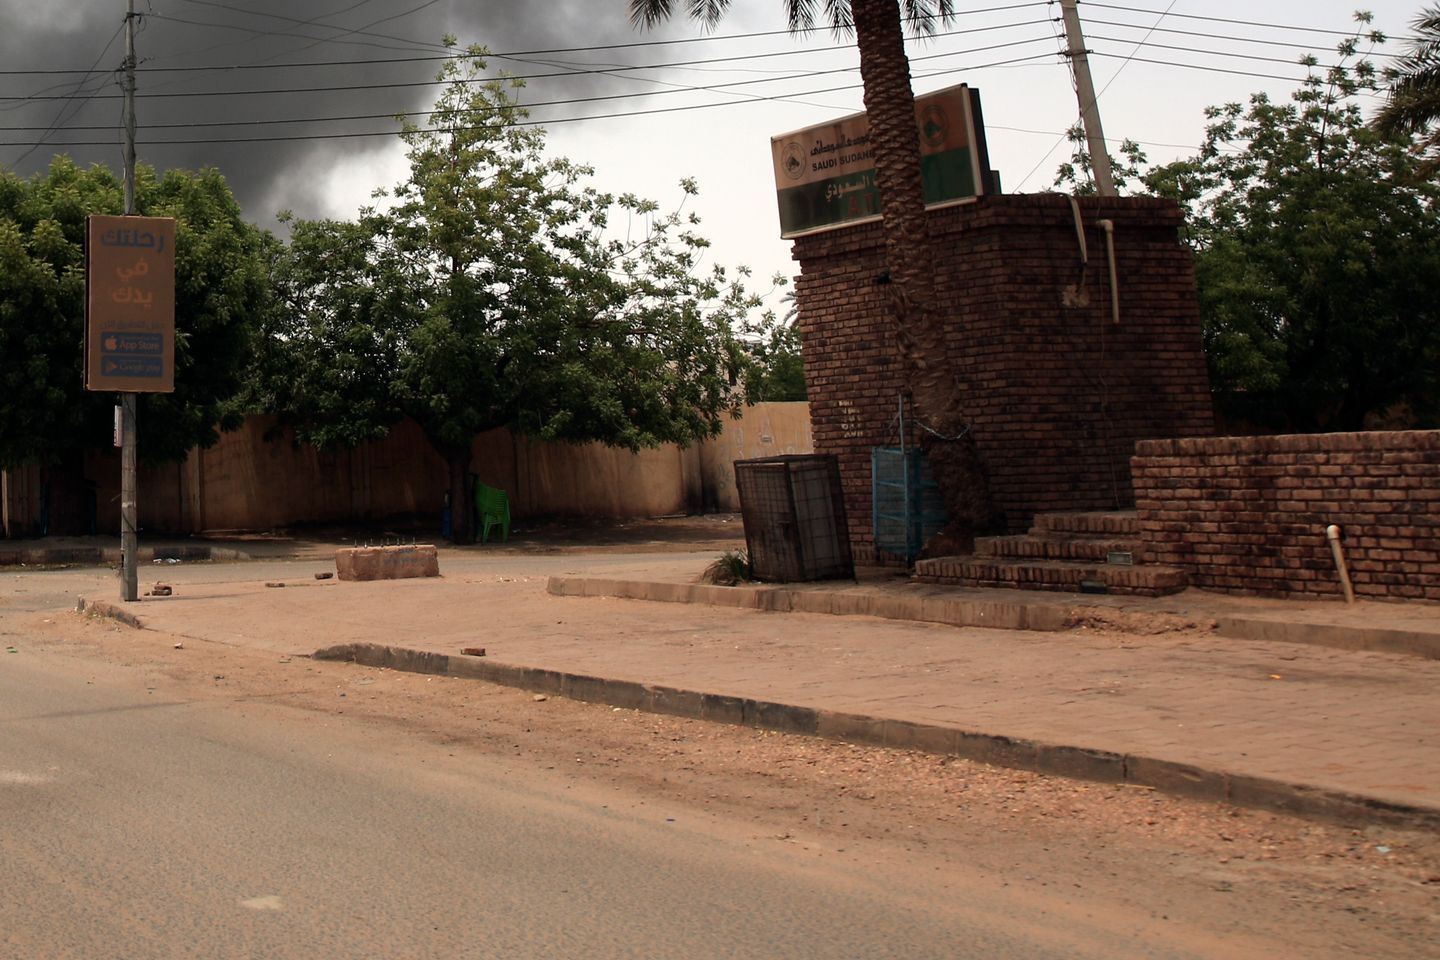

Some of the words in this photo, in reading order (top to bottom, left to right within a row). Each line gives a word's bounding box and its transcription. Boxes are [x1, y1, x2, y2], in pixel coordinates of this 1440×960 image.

[812, 159, 837, 171] SAUDI
[101, 228, 164, 254] رحلتك
[116, 257, 149, 282] في
[112, 286, 153, 310] يدك
